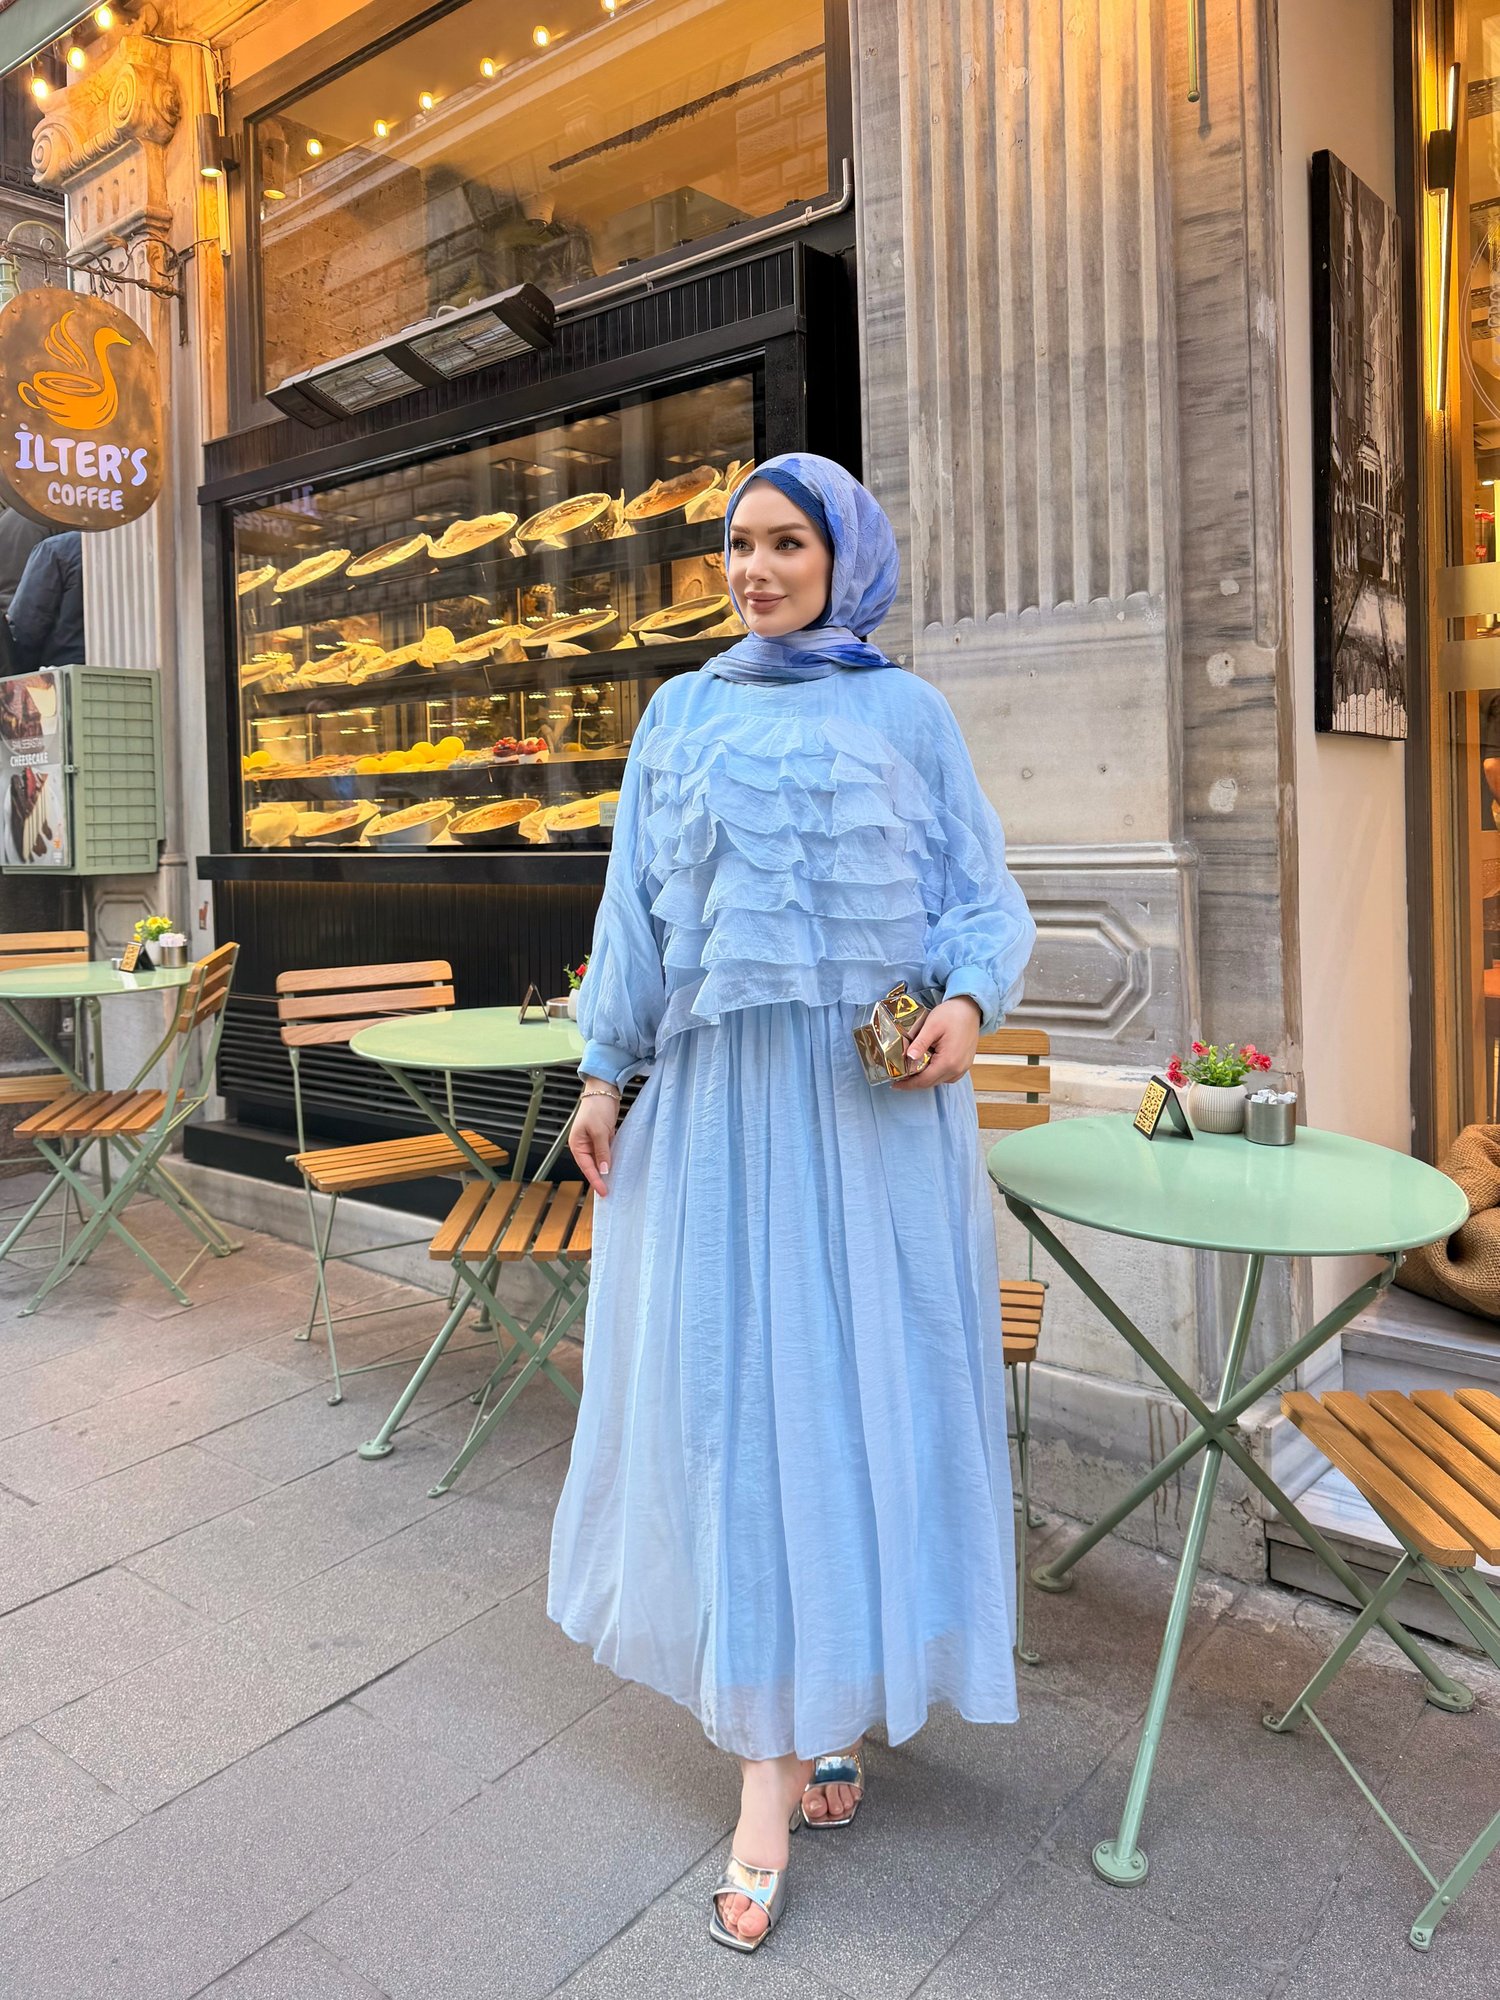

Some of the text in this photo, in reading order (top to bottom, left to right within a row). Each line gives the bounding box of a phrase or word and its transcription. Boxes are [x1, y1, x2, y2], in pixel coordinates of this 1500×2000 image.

[14, 422, 148, 487] İLTER'S
[47, 481, 124, 512] COFFEE
[10, 752, 49, 767] CHEESECAKE
